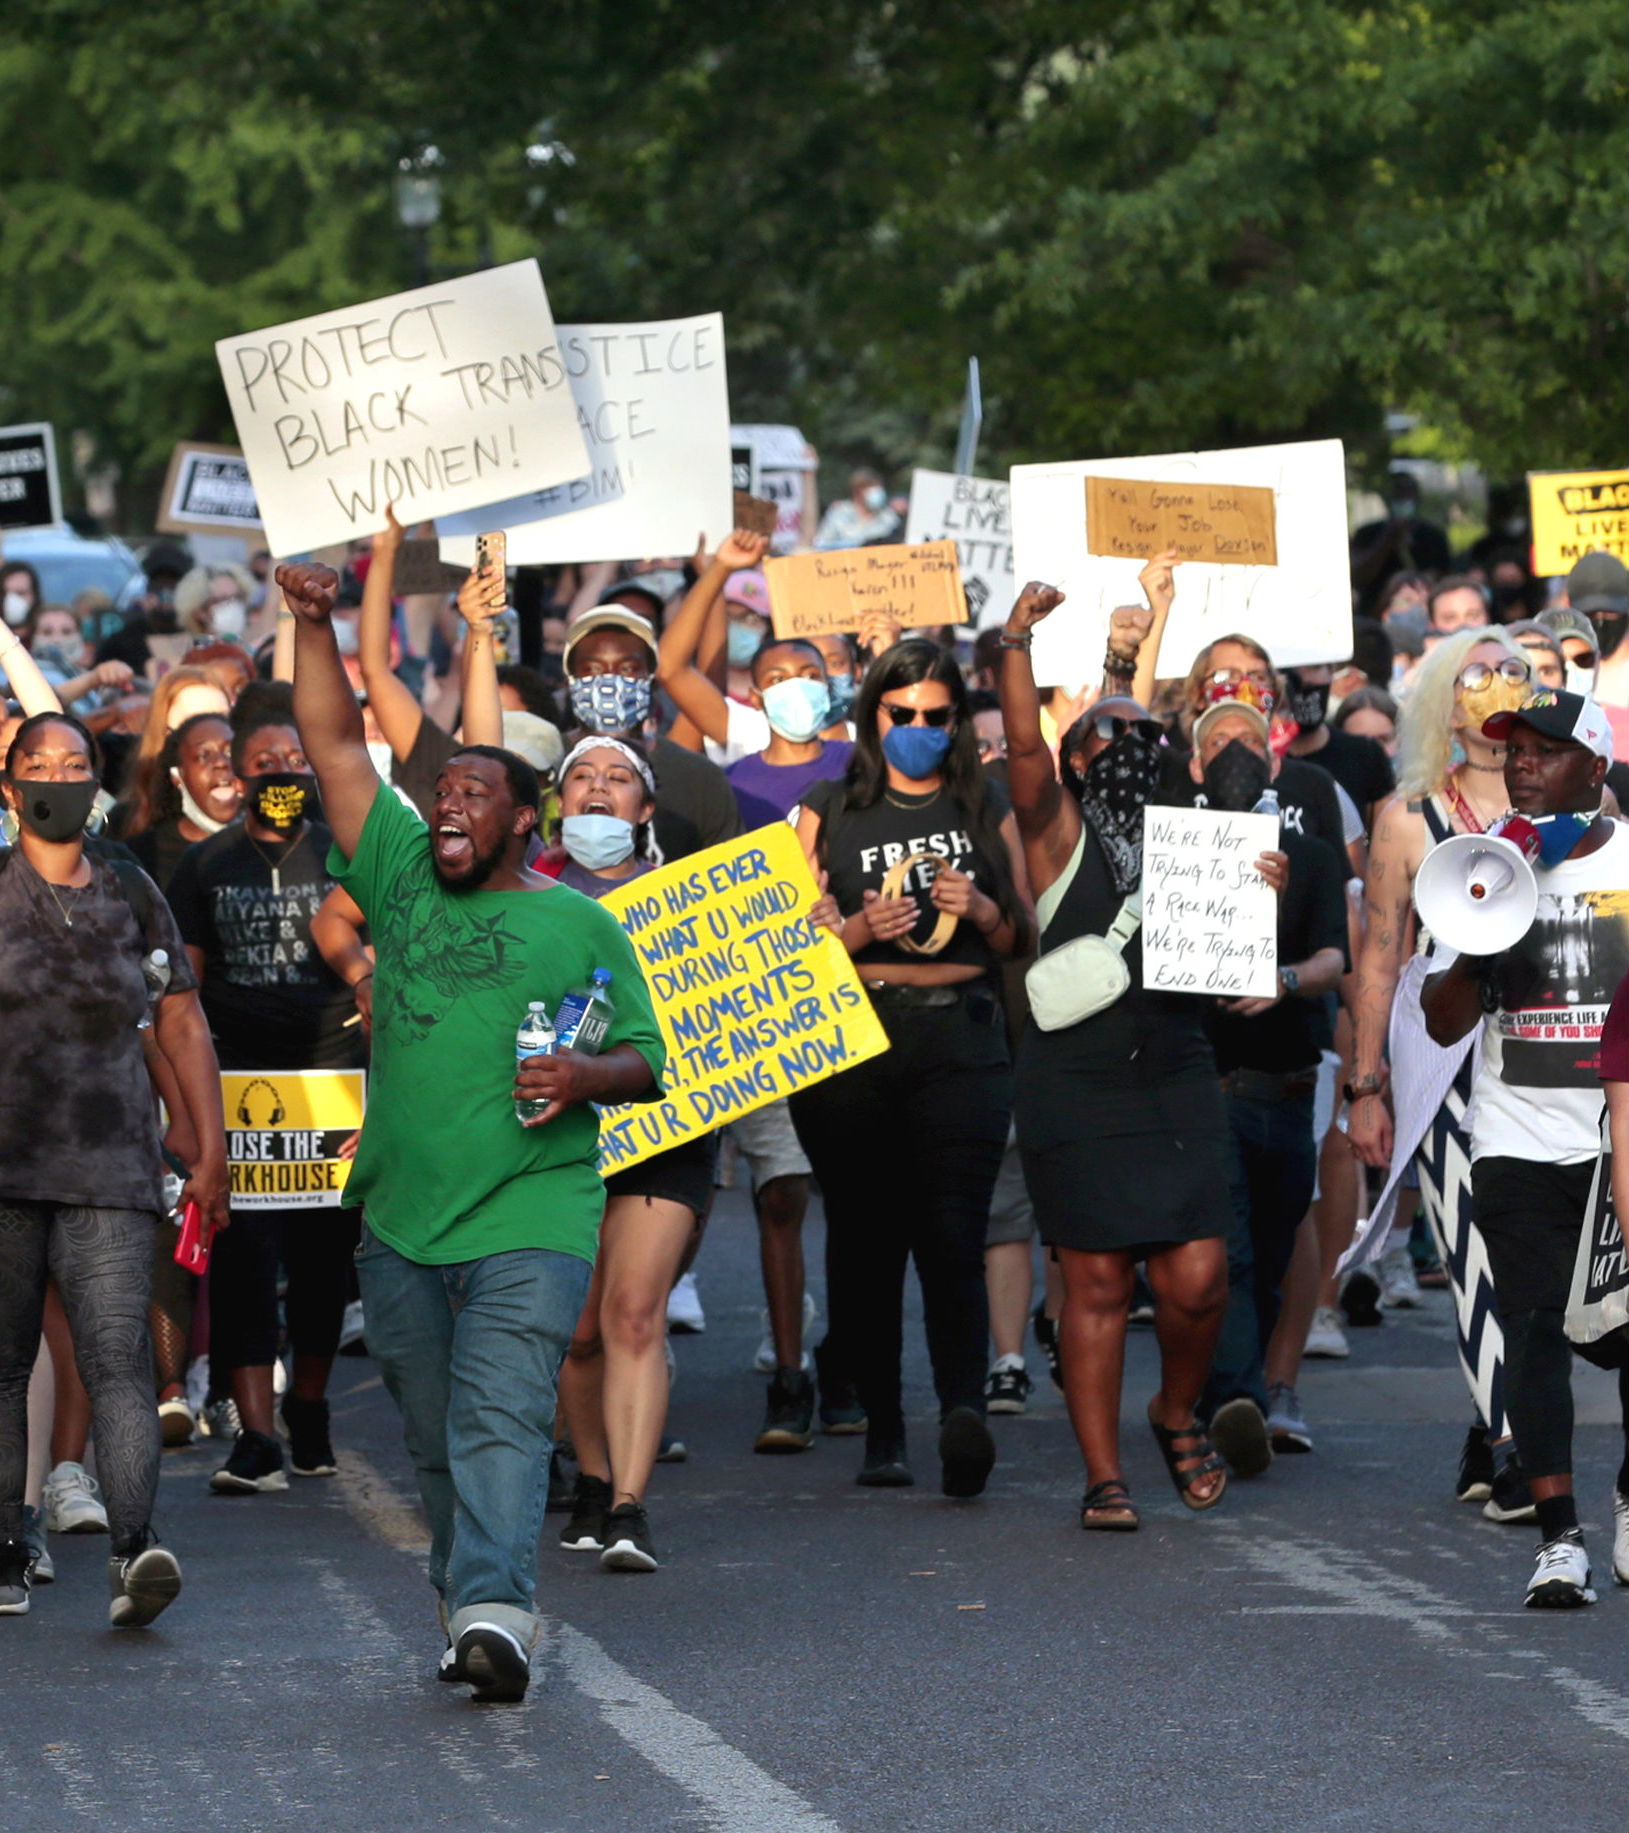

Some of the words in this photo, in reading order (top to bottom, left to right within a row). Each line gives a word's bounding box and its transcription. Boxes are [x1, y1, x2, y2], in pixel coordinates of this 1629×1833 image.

[235, 300, 456, 412] PROTECT
[560, 327, 714, 377] STICE
[274, 384, 428, 470] BLACK
[441, 345, 567, 409] TRANS
[327, 425, 520, 522] WOMEN!
[1177, 514, 1213, 532] Job
[860, 830, 974, 873] FRESH
[663, 873, 708, 914] HAS
[707, 849, 771, 894] EVER
[1145, 891, 1155, 915] A
[280, 920, 296, 939] &
[639, 916, 699, 965] WHAT
[707, 908, 729, 939] U
[731, 881, 799, 929] WOULD
[293, 940, 308, 961] &
[651, 942, 748, 1002] DURING
[743, 915, 824, 969] THOSE
[669, 959, 815, 1050] MOMENTS
[1517, 1011, 1574, 1025] EXPERIENCE
[1577, 1011, 1598, 1024] LIFE
[682, 1035, 731, 1081] THE
[729, 996, 827, 1063] ANSWER
[829, 983, 861, 1013] IS
[1544, 1025, 1556, 1038] OF
[1561, 1025, 1581, 1038] YOU
[595, 1117, 638, 1171] HAT
[638, 1111, 662, 1145] U
[660, 1102, 691, 1138] R
[688, 1060, 777, 1125] DOING
[778, 1024, 857, 1088] NOW.
[228, 1131, 275, 1160] OSE
[281, 1131, 325, 1160] THE
[230, 1163, 339, 1193] RKHOUSE
